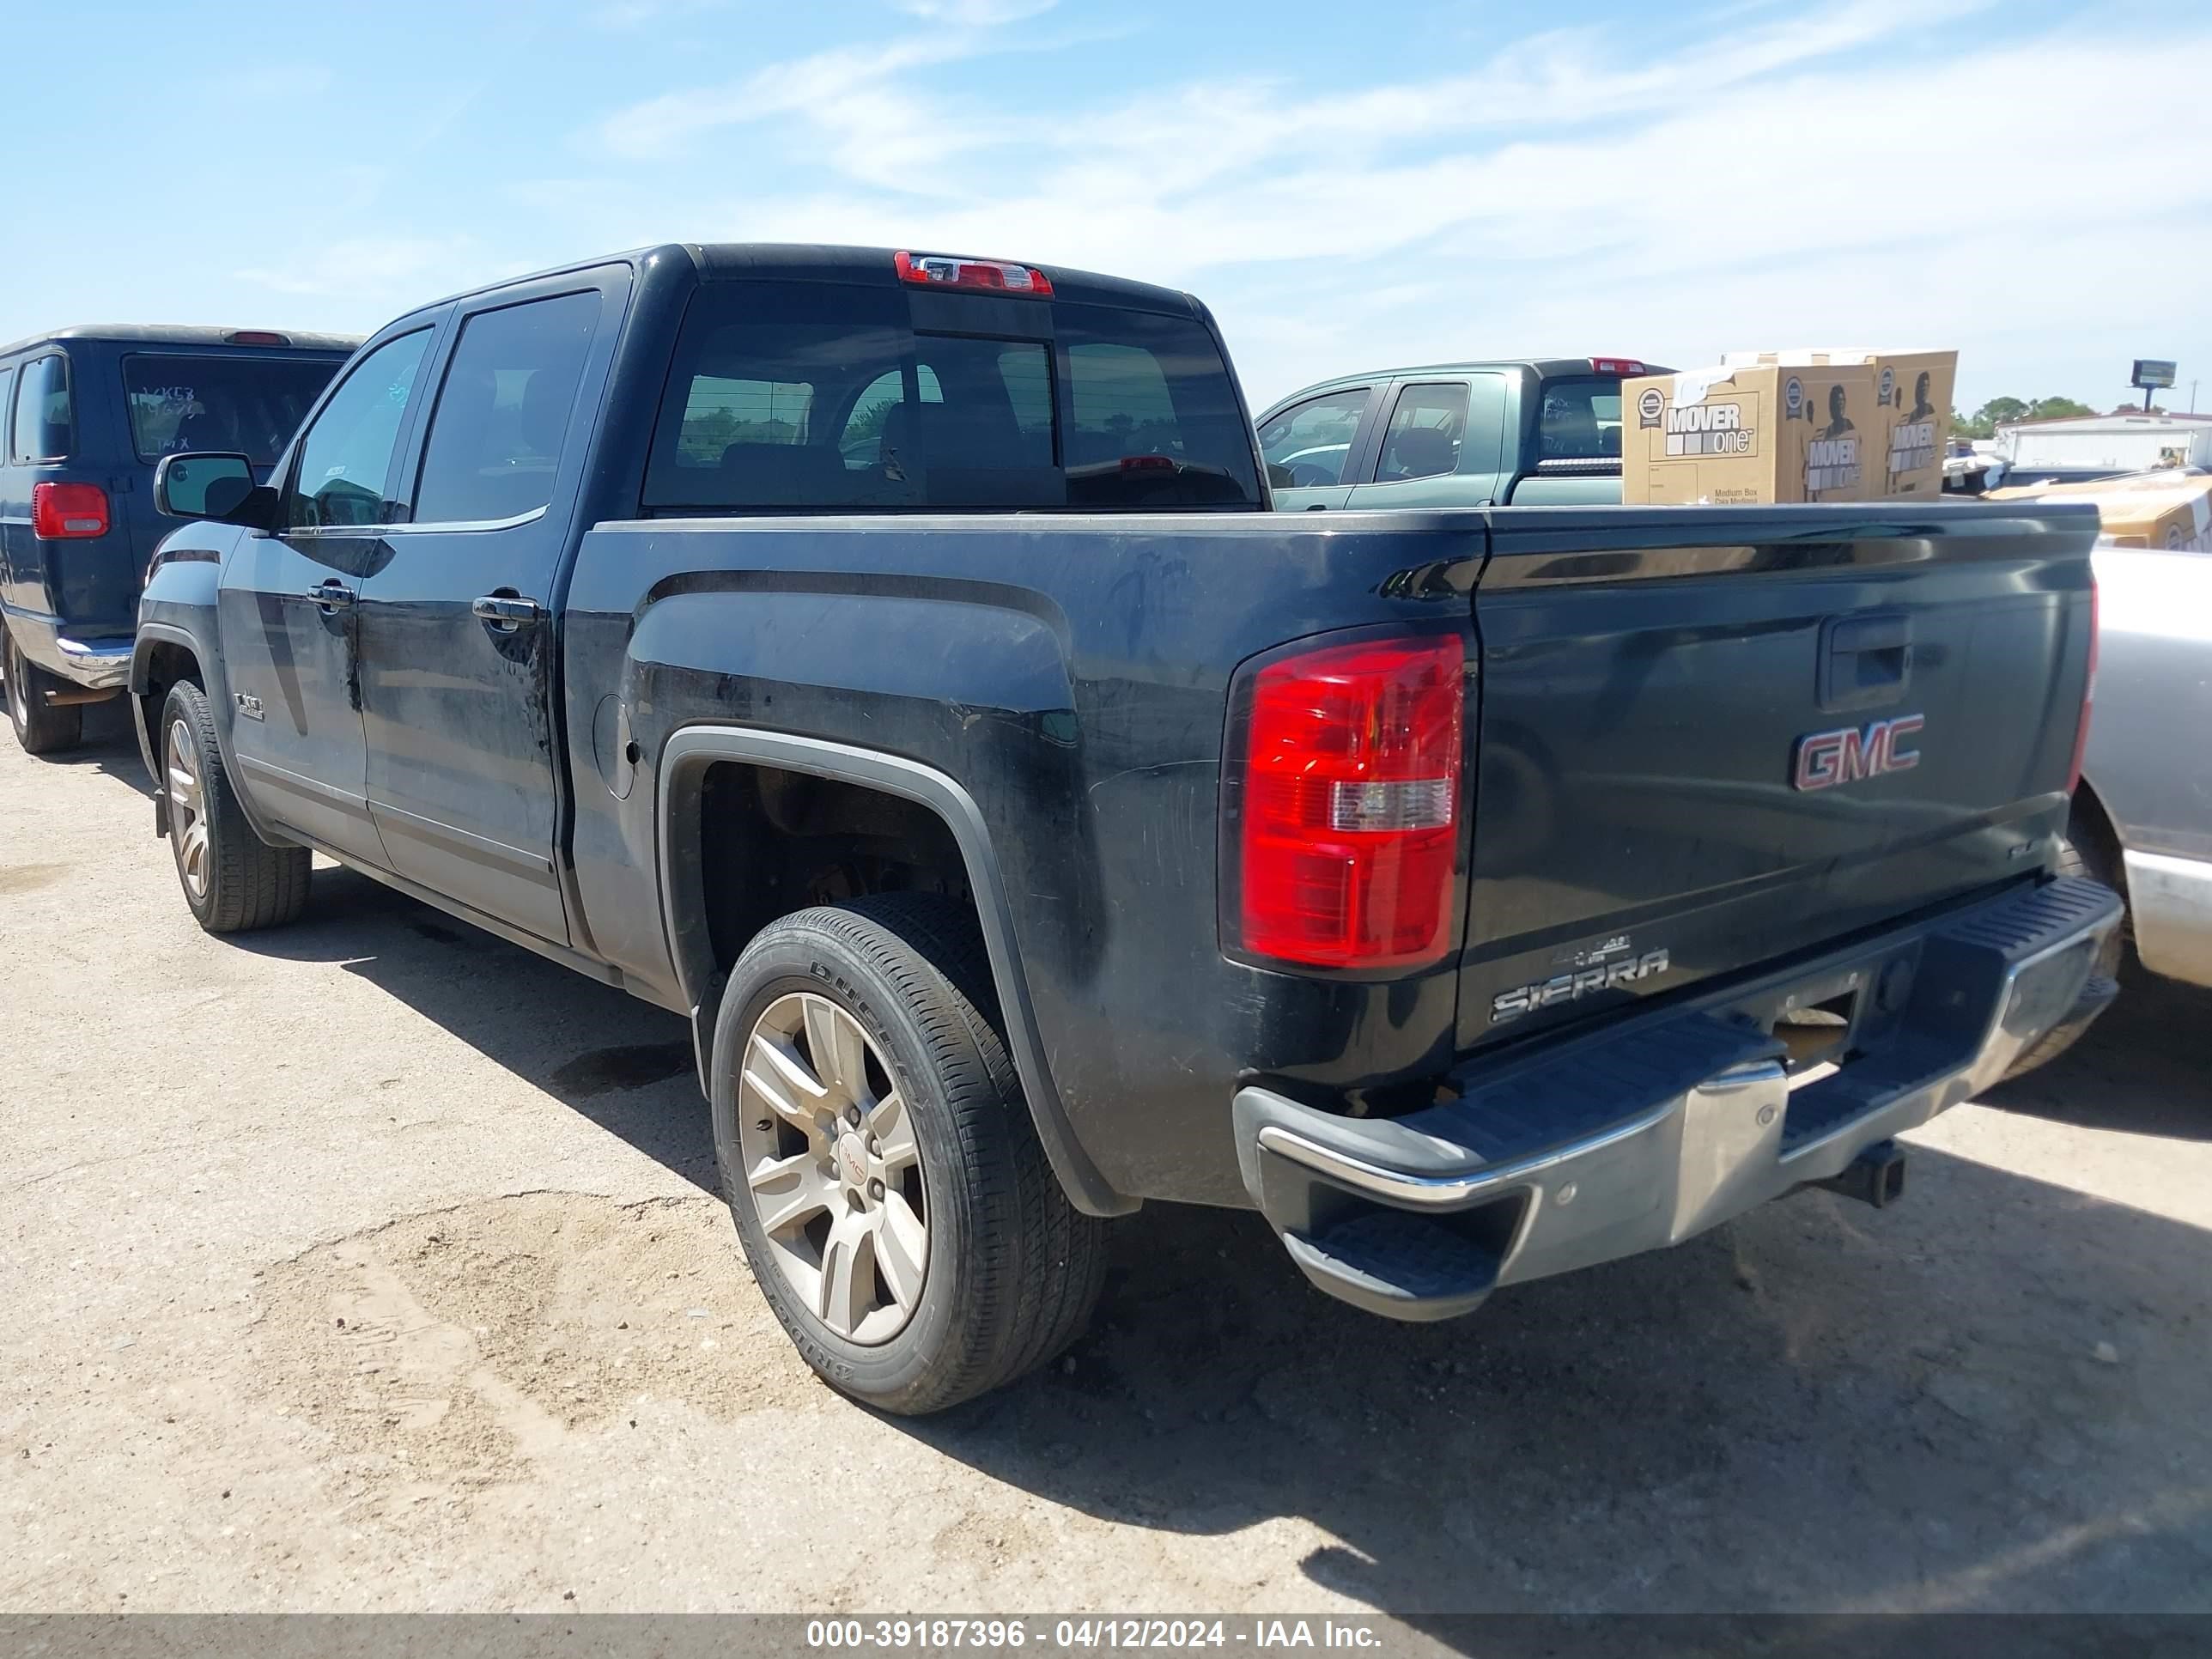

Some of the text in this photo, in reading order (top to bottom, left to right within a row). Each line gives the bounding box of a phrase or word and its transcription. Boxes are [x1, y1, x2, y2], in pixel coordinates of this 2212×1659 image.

[1668, 404, 1741, 433] MOVER
[1714, 430, 1749, 453] one
[1893, 424, 1934, 452] MOVER
[1808, 440, 1856, 468] MOVER
[1715, 488, 1758, 497] Medium Box
[1795, 714, 1925, 791] GMC
[1491, 948, 1670, 1023] SIERRA
